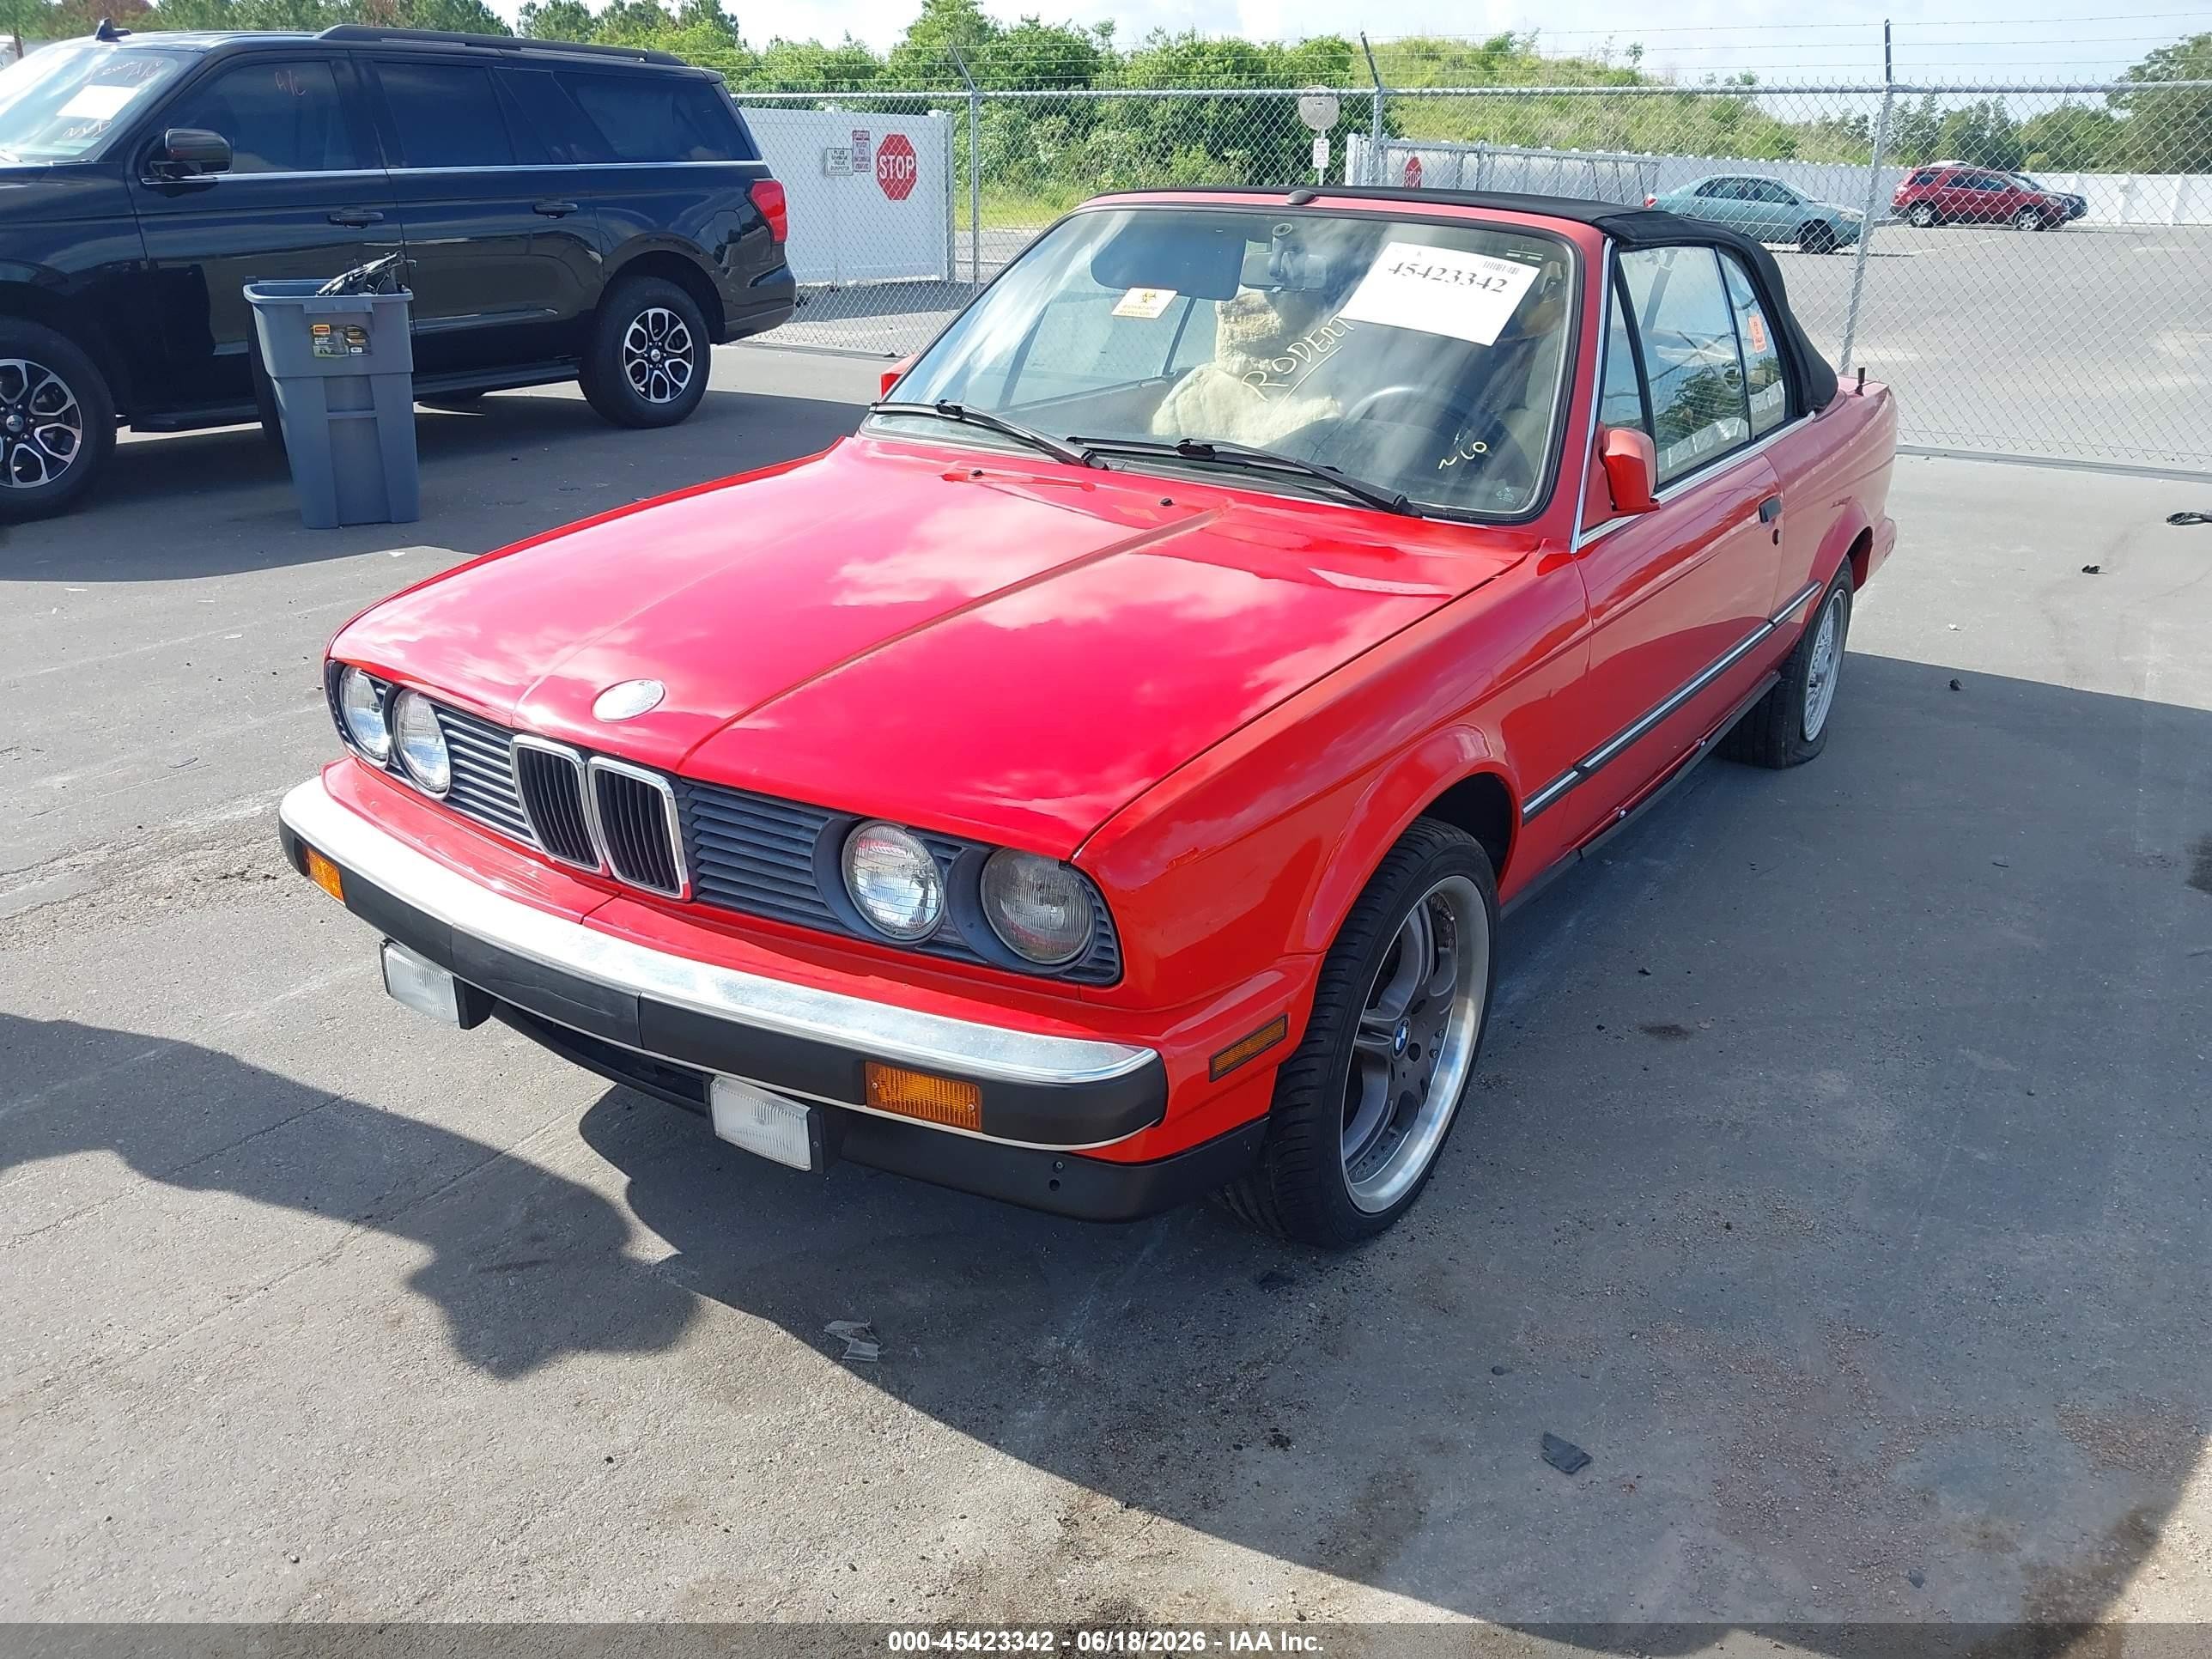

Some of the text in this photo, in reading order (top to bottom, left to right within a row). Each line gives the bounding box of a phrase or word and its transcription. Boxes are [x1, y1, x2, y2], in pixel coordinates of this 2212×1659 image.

[878, 155, 915, 179] STOP
[1388, 261, 1509, 294] 45423342
[1241, 313, 1355, 402] RODENT
